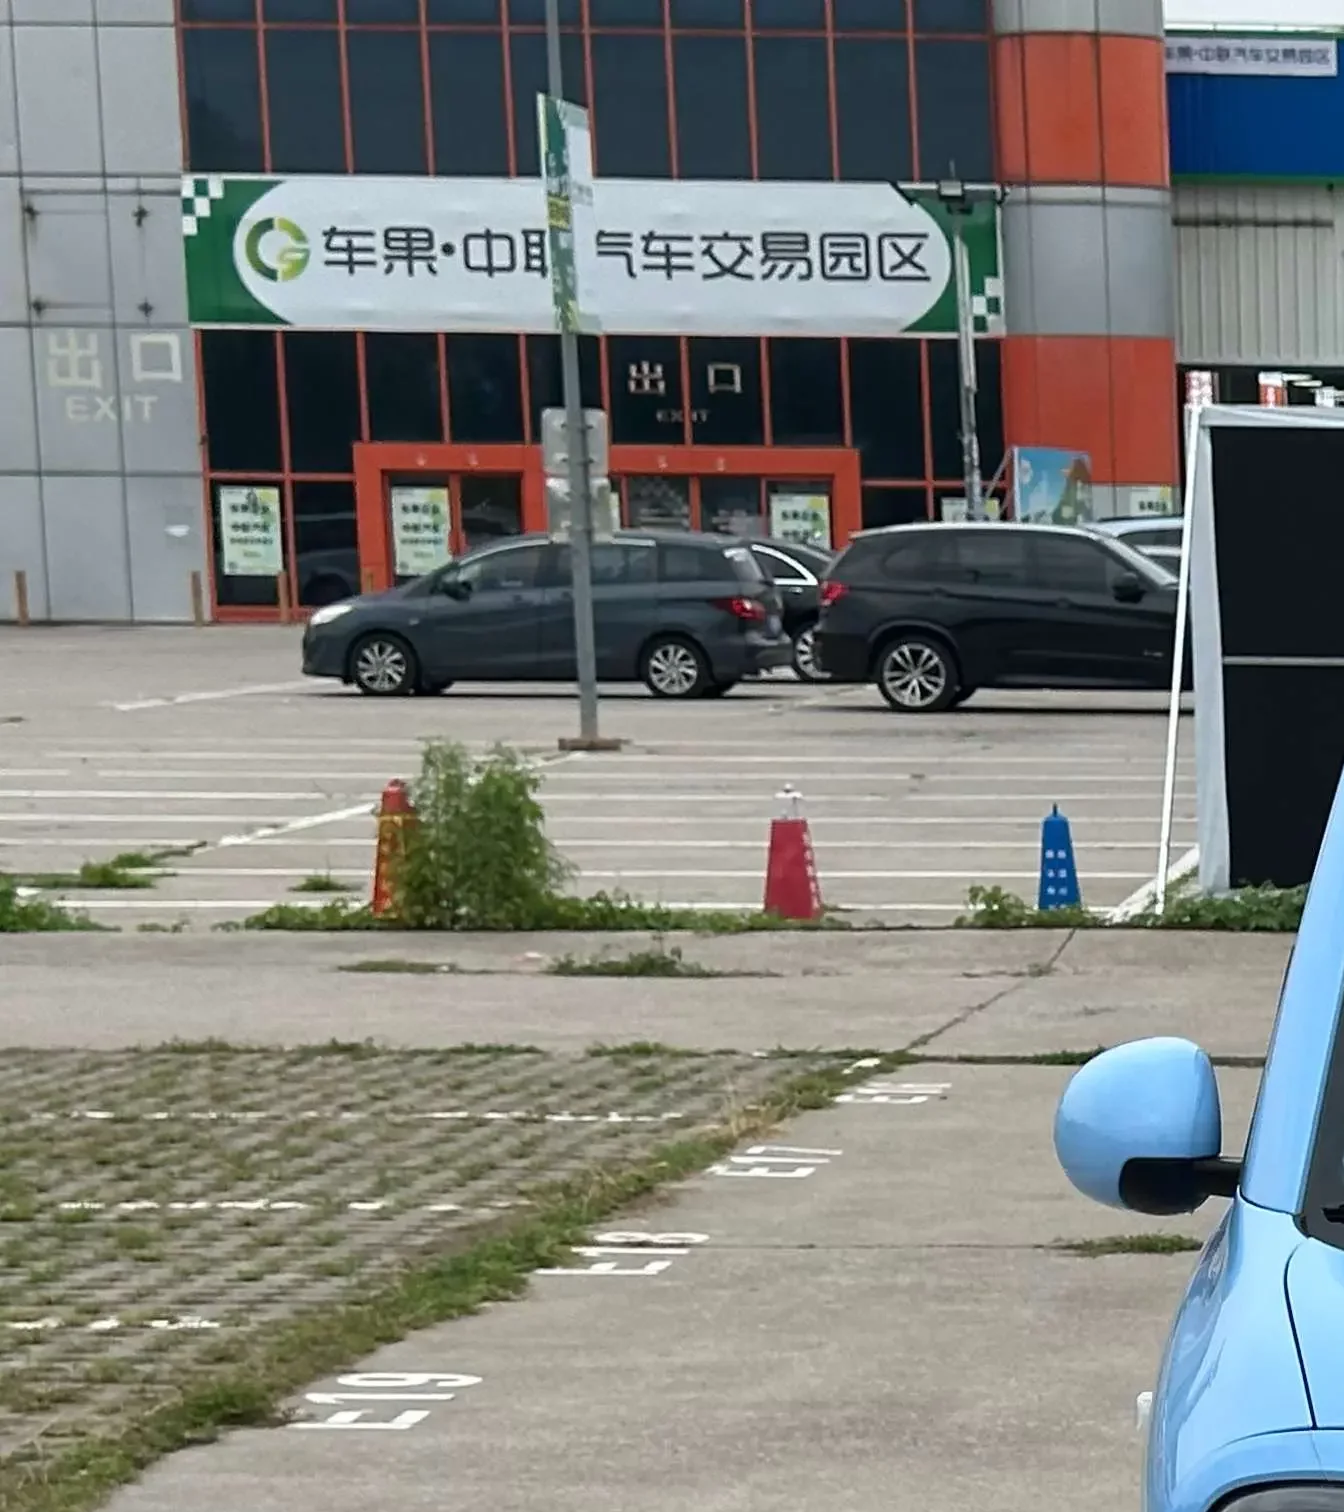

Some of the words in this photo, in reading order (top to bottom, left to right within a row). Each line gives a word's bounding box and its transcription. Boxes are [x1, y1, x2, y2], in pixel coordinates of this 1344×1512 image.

[48, 329, 182, 388] 出口
[628, 361, 741, 396] 出口
[66, 395, 158, 423] EXIT
